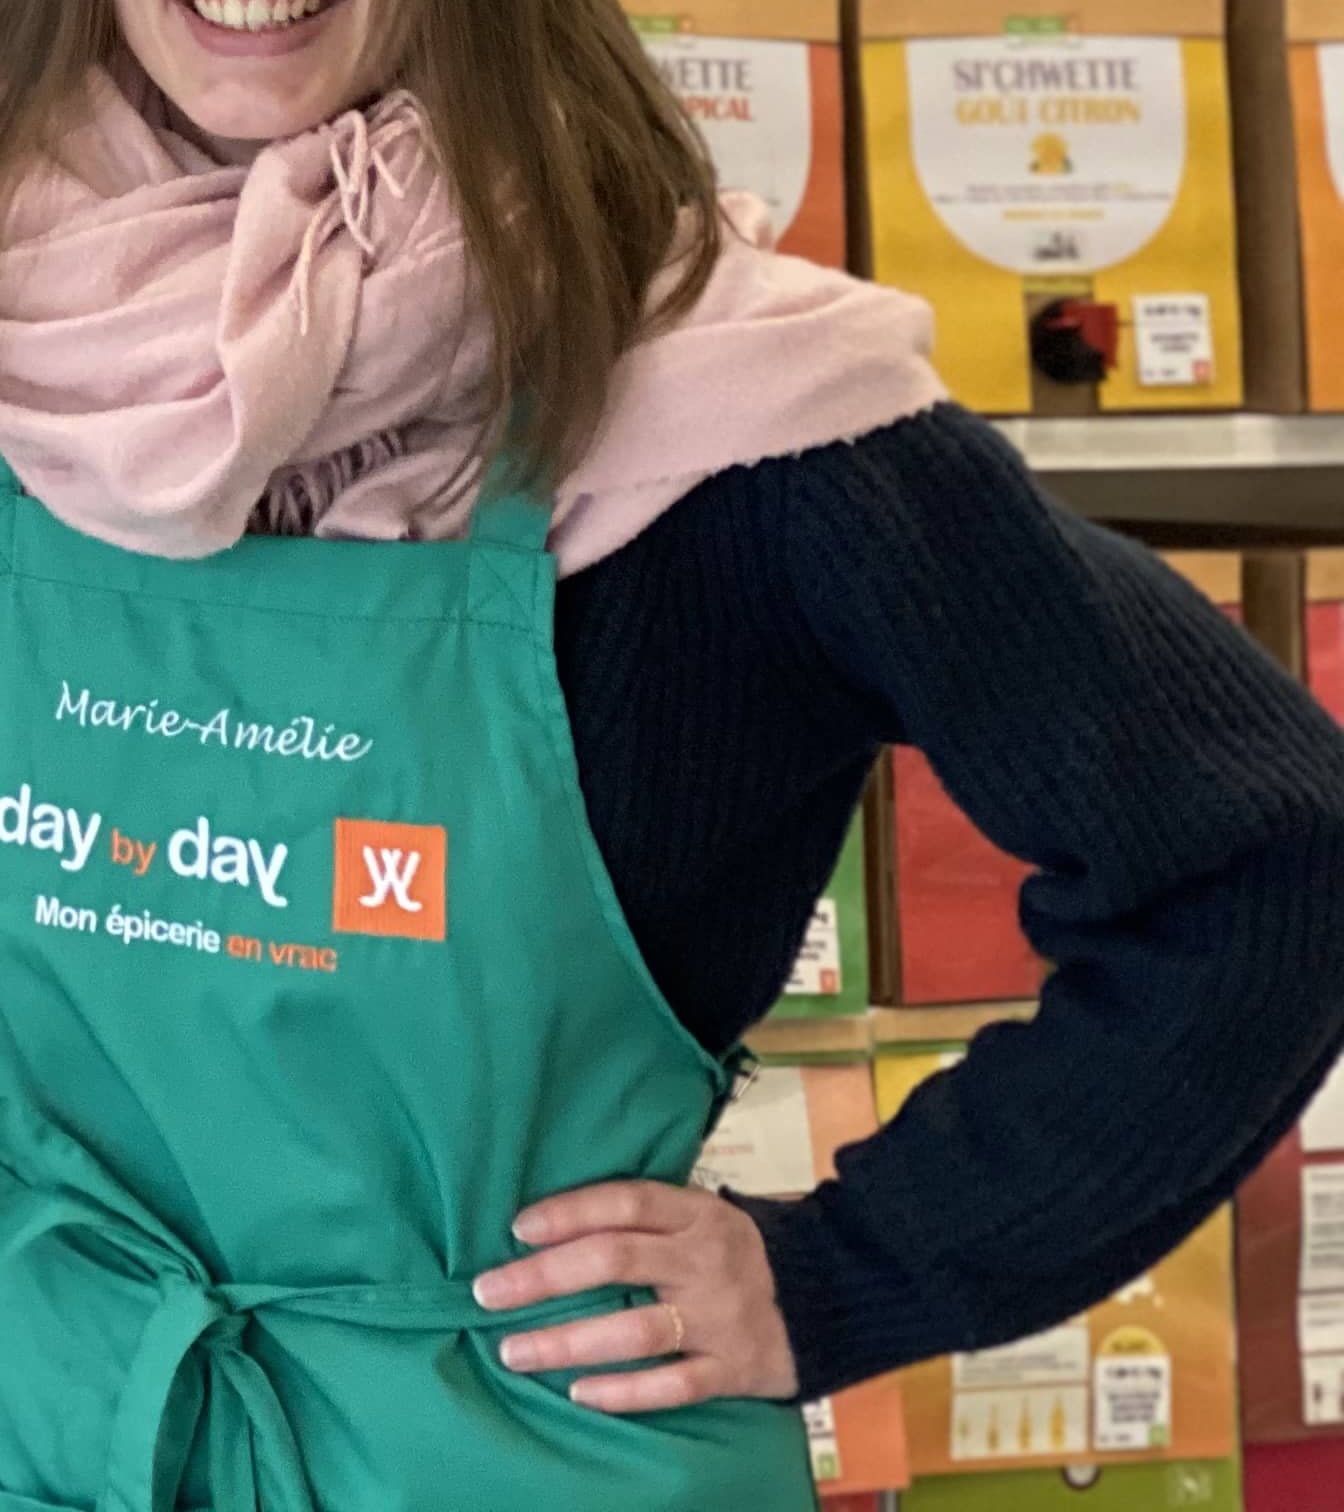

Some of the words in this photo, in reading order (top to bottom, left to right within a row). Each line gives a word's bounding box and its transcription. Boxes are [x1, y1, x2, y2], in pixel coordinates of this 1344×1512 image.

[1038, 96, 1141, 126] CITRON
[55, 679, 374, 762] Marie-Amélie
[111, 828, 156, 875] by
[168, 815, 288, 908] day
[34, 895, 96, 932] Mon
[106, 904, 220, 953] épicerie
[226, 933, 261, 963] en
[269, 943, 337, 972] vrac
